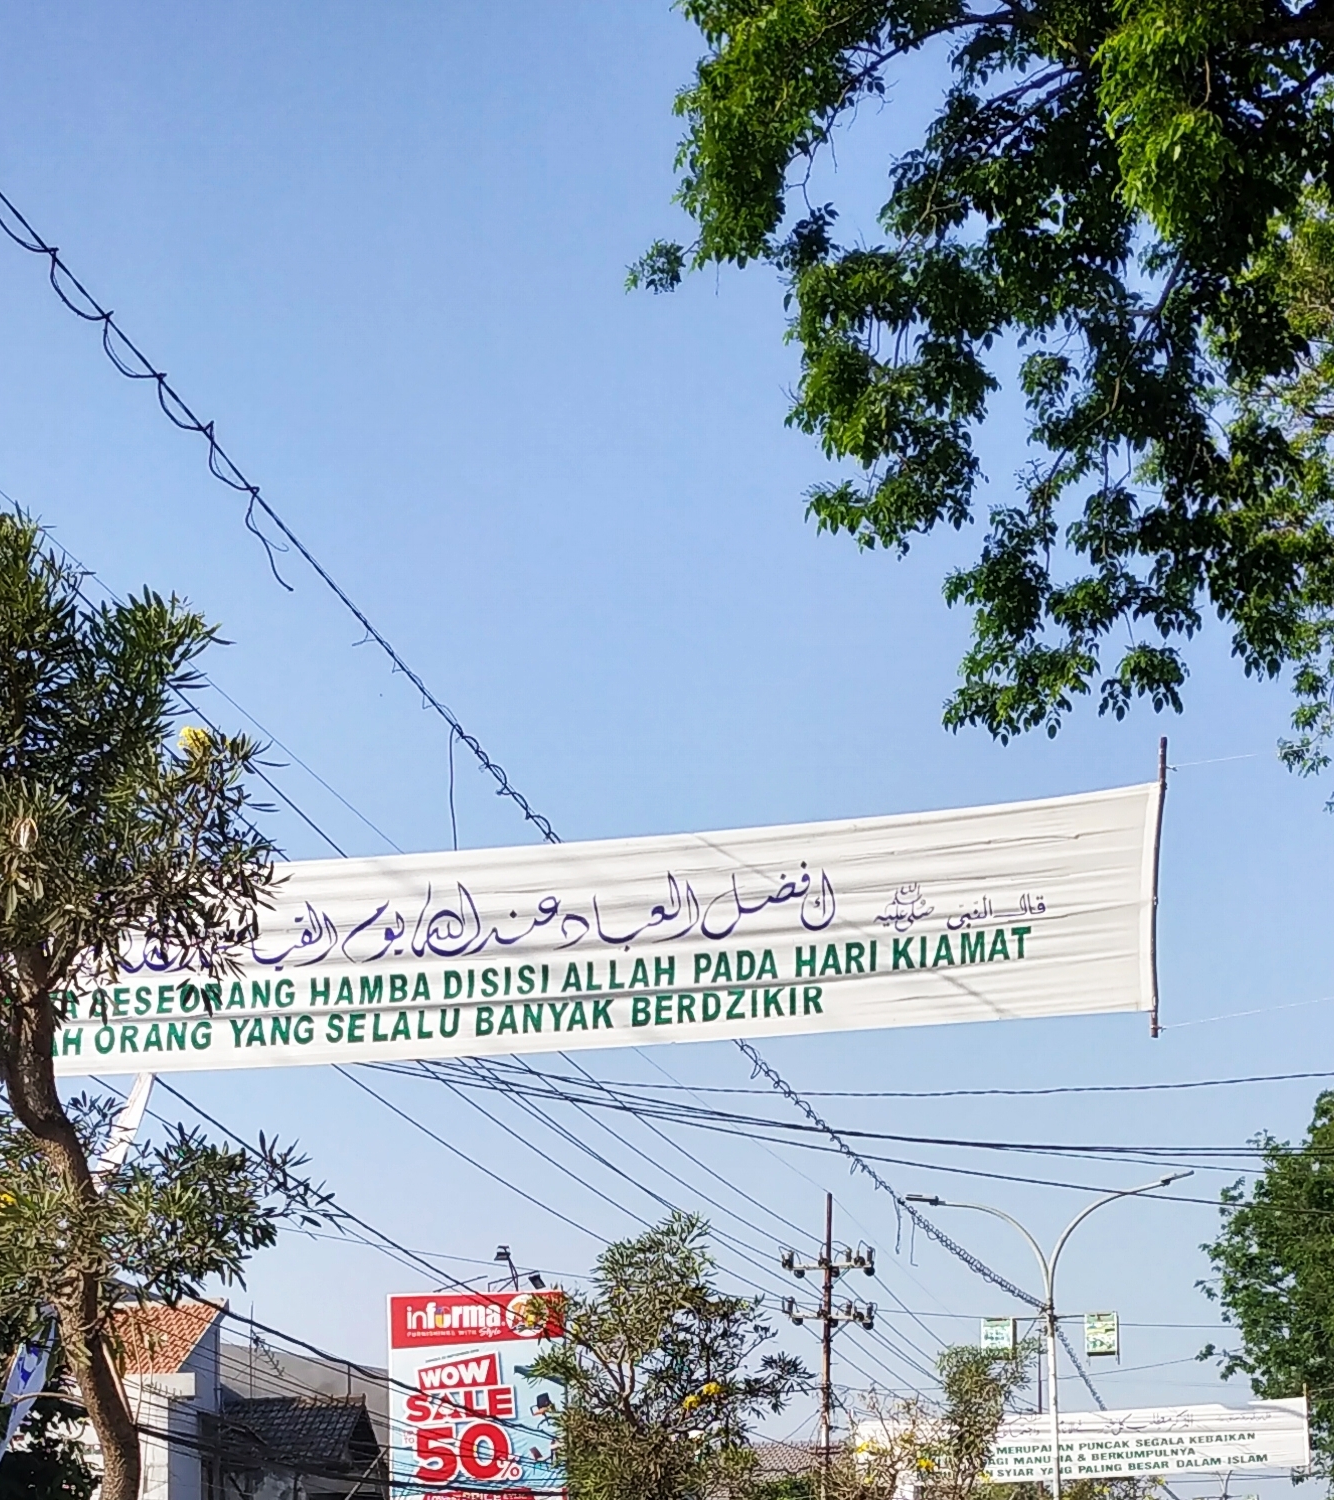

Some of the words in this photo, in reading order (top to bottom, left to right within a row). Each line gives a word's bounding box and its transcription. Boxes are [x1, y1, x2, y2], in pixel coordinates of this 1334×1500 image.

[310, 972, 431, 1006] HAMBA
[444, 964, 549, 999] DISISI
[562, 955, 675, 993] ALLAH
[694, 949, 779, 984] PADA
[795, 940, 877, 978] HARI
[892, 926, 1032, 971] KIAMAT
[94, 1020, 212, 1056] ORANG
[229, 1013, 315, 1049] YANG
[326, 1007, 460, 1044] SELALU
[475, 998, 615, 1036] BANYAK
[631, 985, 824, 1028] BERDZIKIR
[420, 1358, 490, 1388] WOW
[406, 1386, 513, 1423] SALE
[1014, 1455, 1073, 1466] MANUIA
[1091, 1447, 1195, 1462] BERKUMPULNYA
[1078, 1441, 1130, 1451] PUNCAK
[1135, 1437, 1184, 1448] SEGALA
[997, 1468, 1034, 1478] SYIAR
[1078, 1463, 1122, 1474] PALING
[1128, 1461, 1169, 1471] BESAR
[1176, 1457, 1221, 1469] DALAM
[1227, 1453, 1268, 1465] ISLAM
